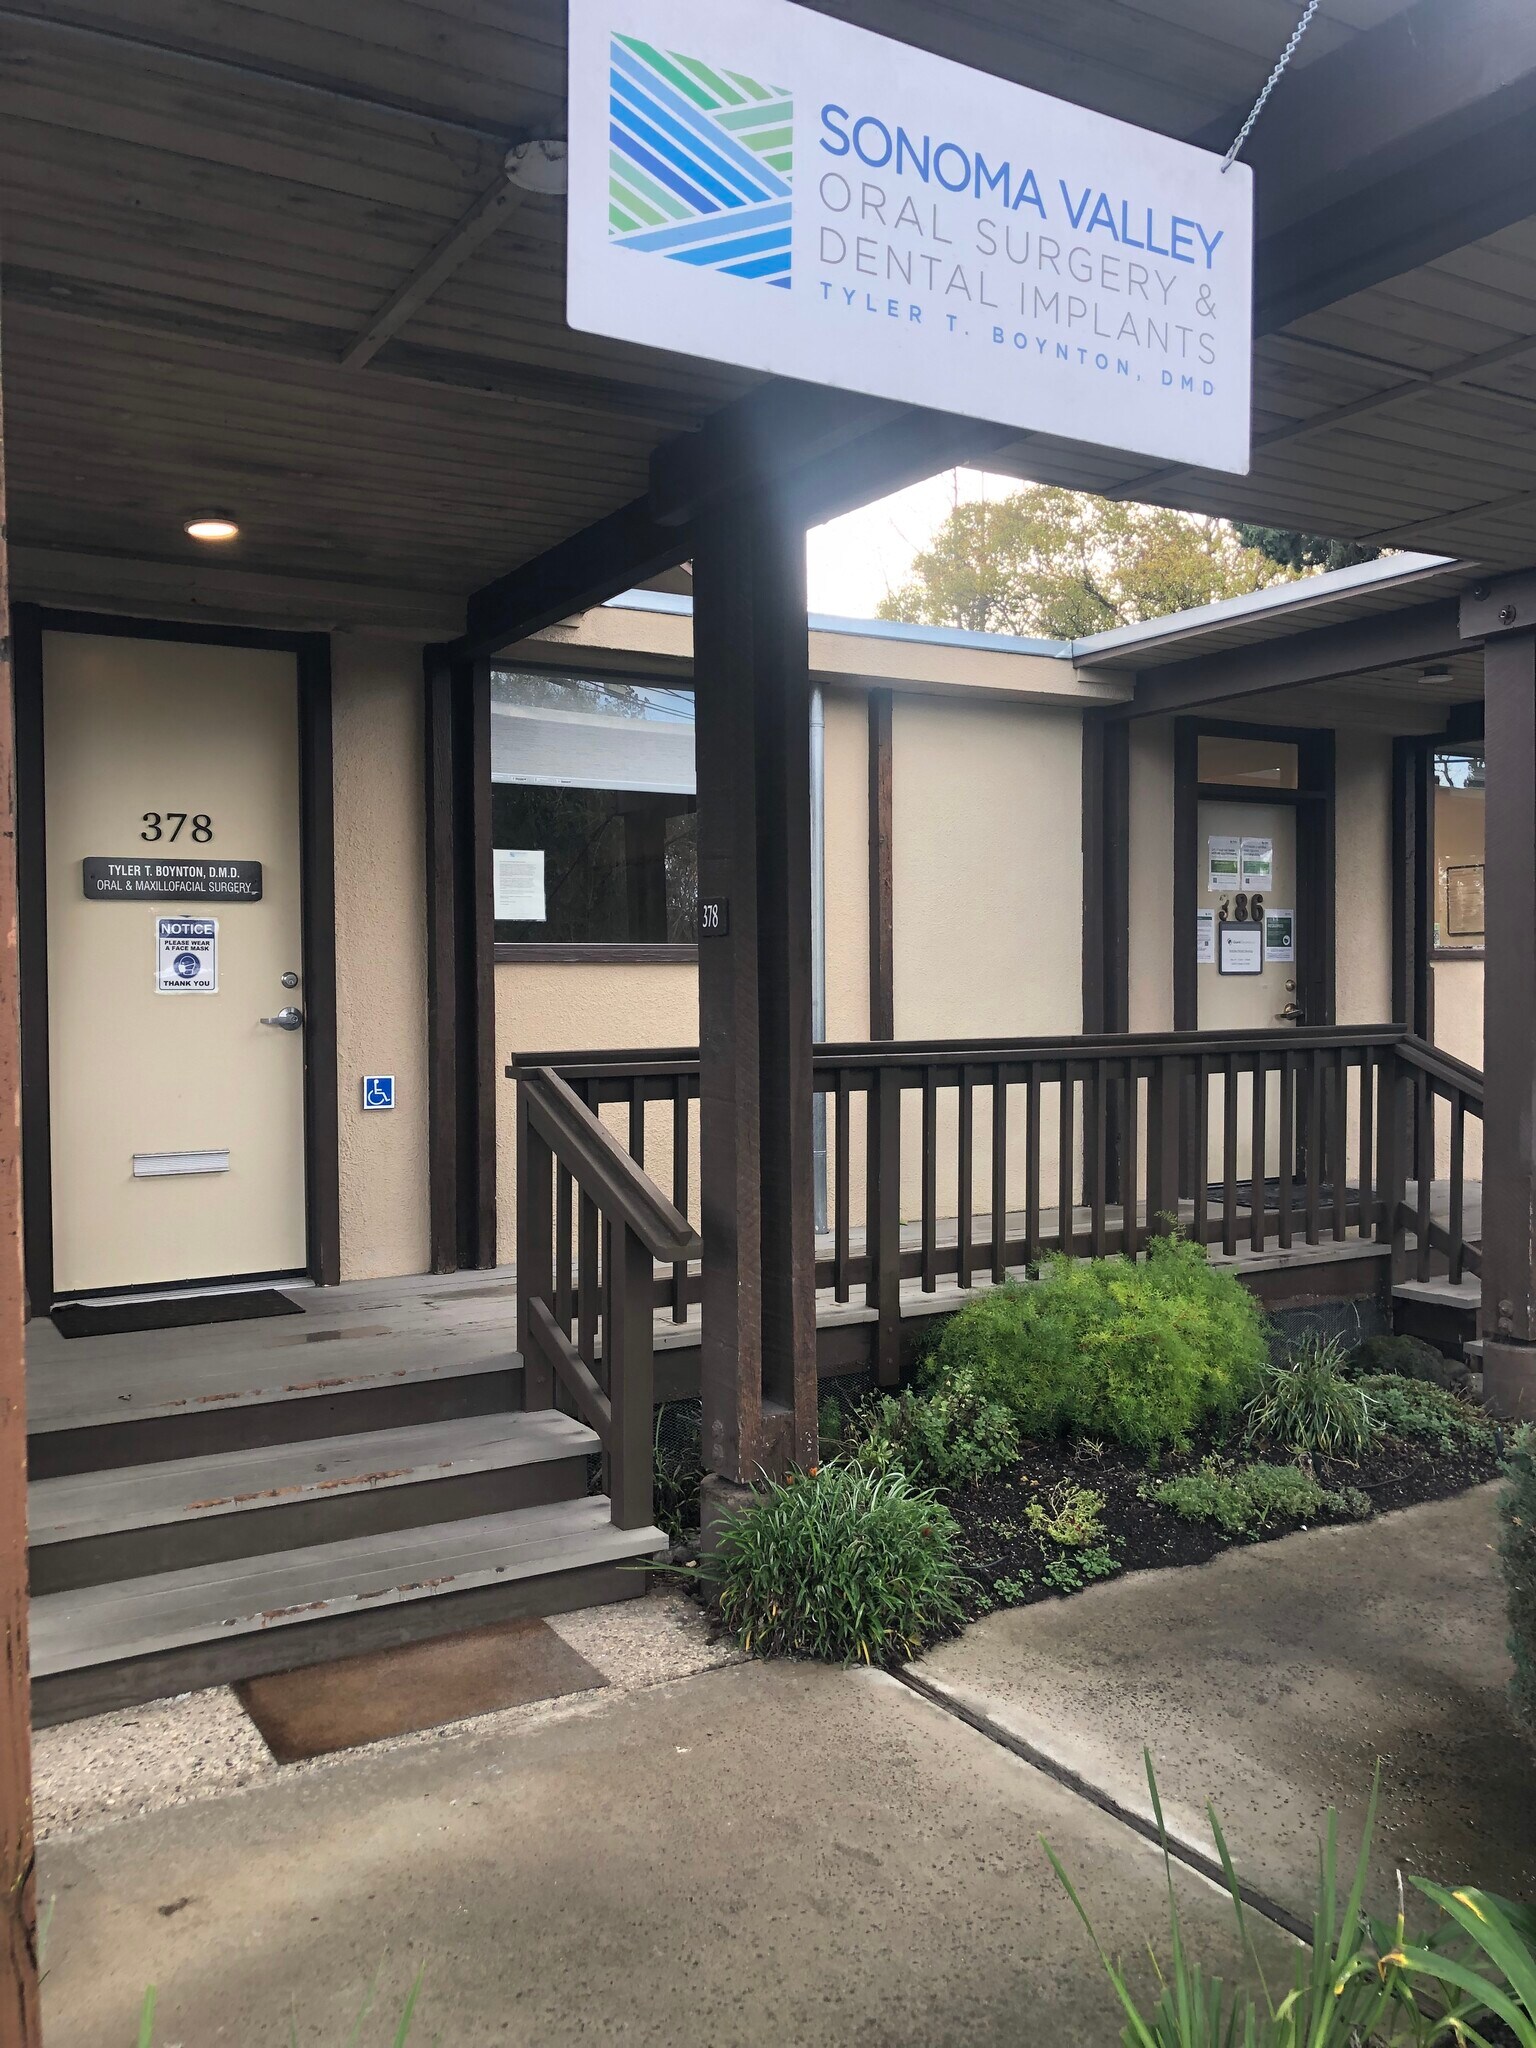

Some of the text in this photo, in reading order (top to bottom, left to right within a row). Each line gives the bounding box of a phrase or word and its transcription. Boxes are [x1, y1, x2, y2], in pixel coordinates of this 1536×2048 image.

[819, 104, 1224, 269] SONOMA VALLEY
[819, 172, 1217, 320] ORAL SURGERY &
[820, 226, 1216, 365] DENTAL IMPLANTS
[820, 281, 1215, 396] TYLER T. BOYNTON, DMD
[140, 812, 213, 843] 378
[97, 879, 251, 894] ORAL & MAXILLOFACIAL SURGERY
[108, 864, 240, 879] TYLER T. BOYNTON, D.M.D.
[161, 923, 213, 935] NOTICE
[702, 904, 719, 928] 378
